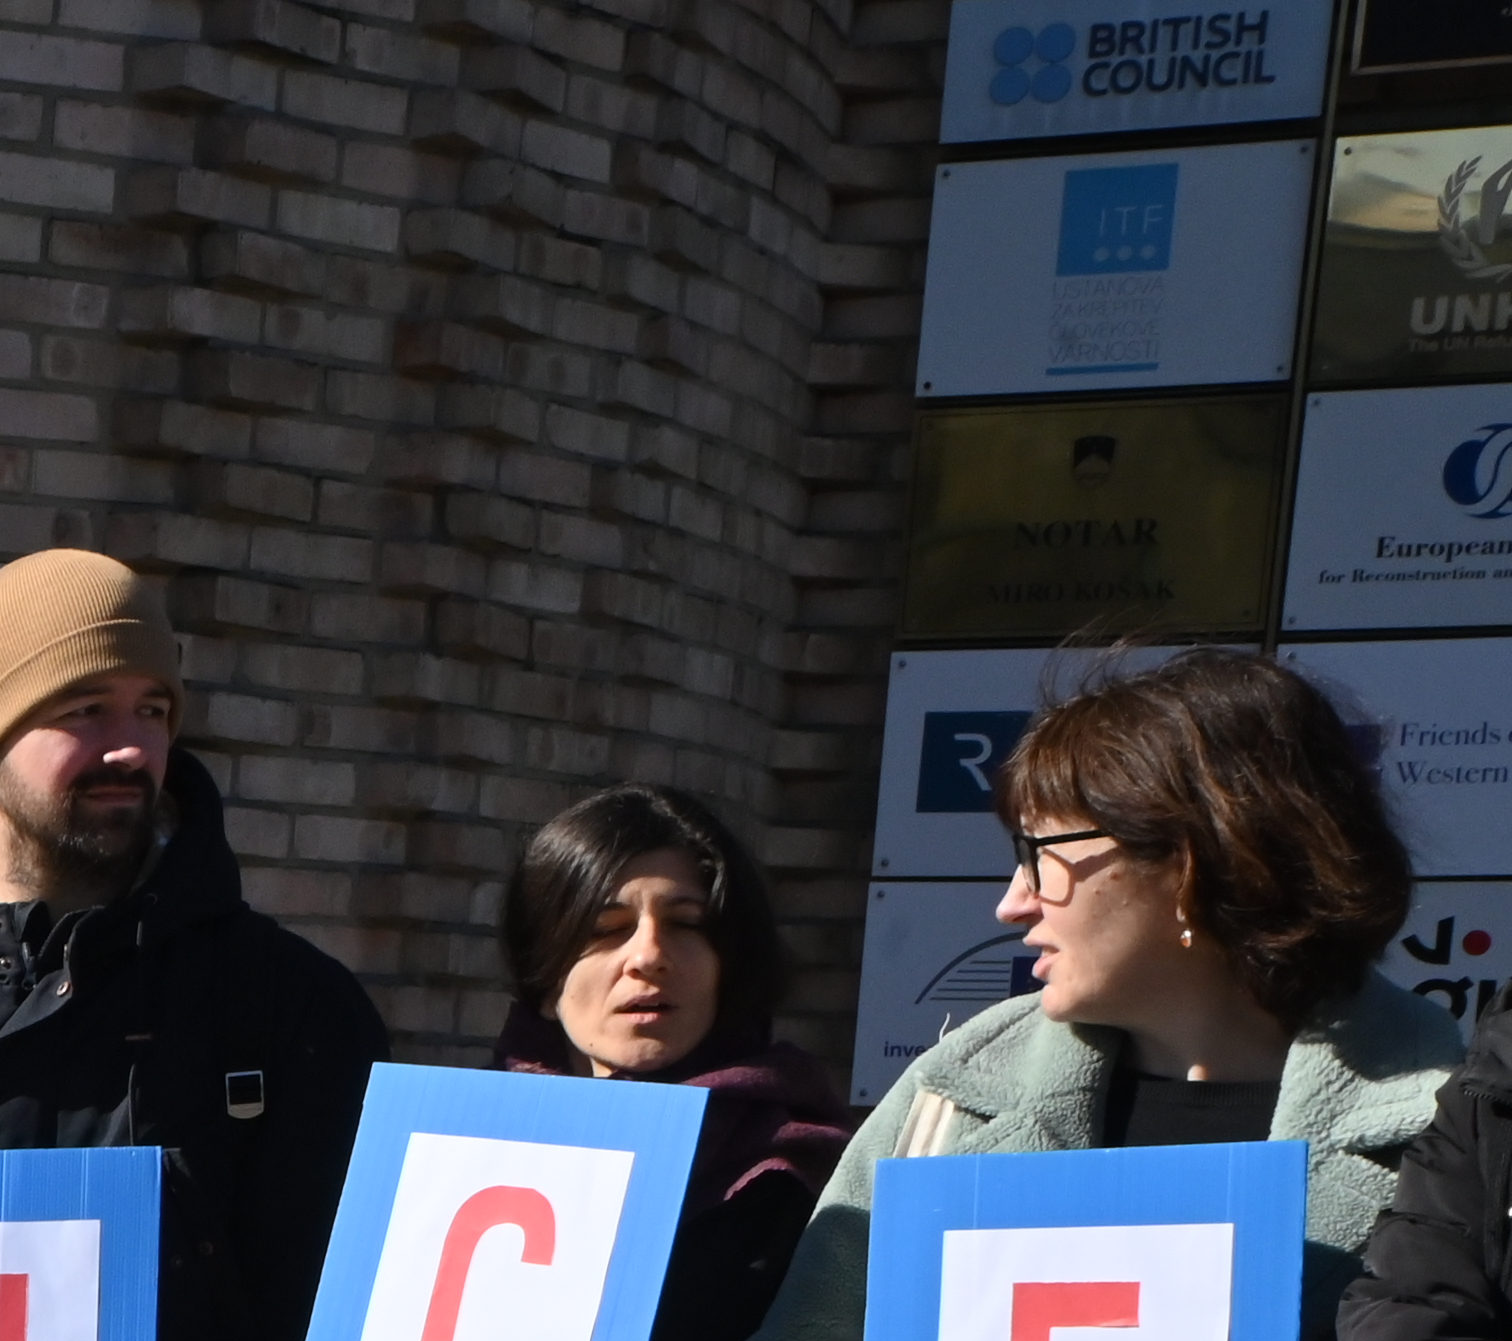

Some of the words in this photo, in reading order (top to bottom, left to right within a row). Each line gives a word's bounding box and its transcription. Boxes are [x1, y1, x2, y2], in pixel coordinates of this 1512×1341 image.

[1088, 10, 1269, 59] BRITISH
[1082, 50, 1276, 96] COUNCIL
[1099, 204, 1165, 237] ITF
[1014, 518, 1160, 549] NOTAR
[1318, 569, 1345, 584] for
[1352, 567, 1487, 583] Reconstruction
[986, 582, 1064, 604] MIRO
[1400, 721, 1501, 746] Friends
[1397, 761, 1508, 784] Western
